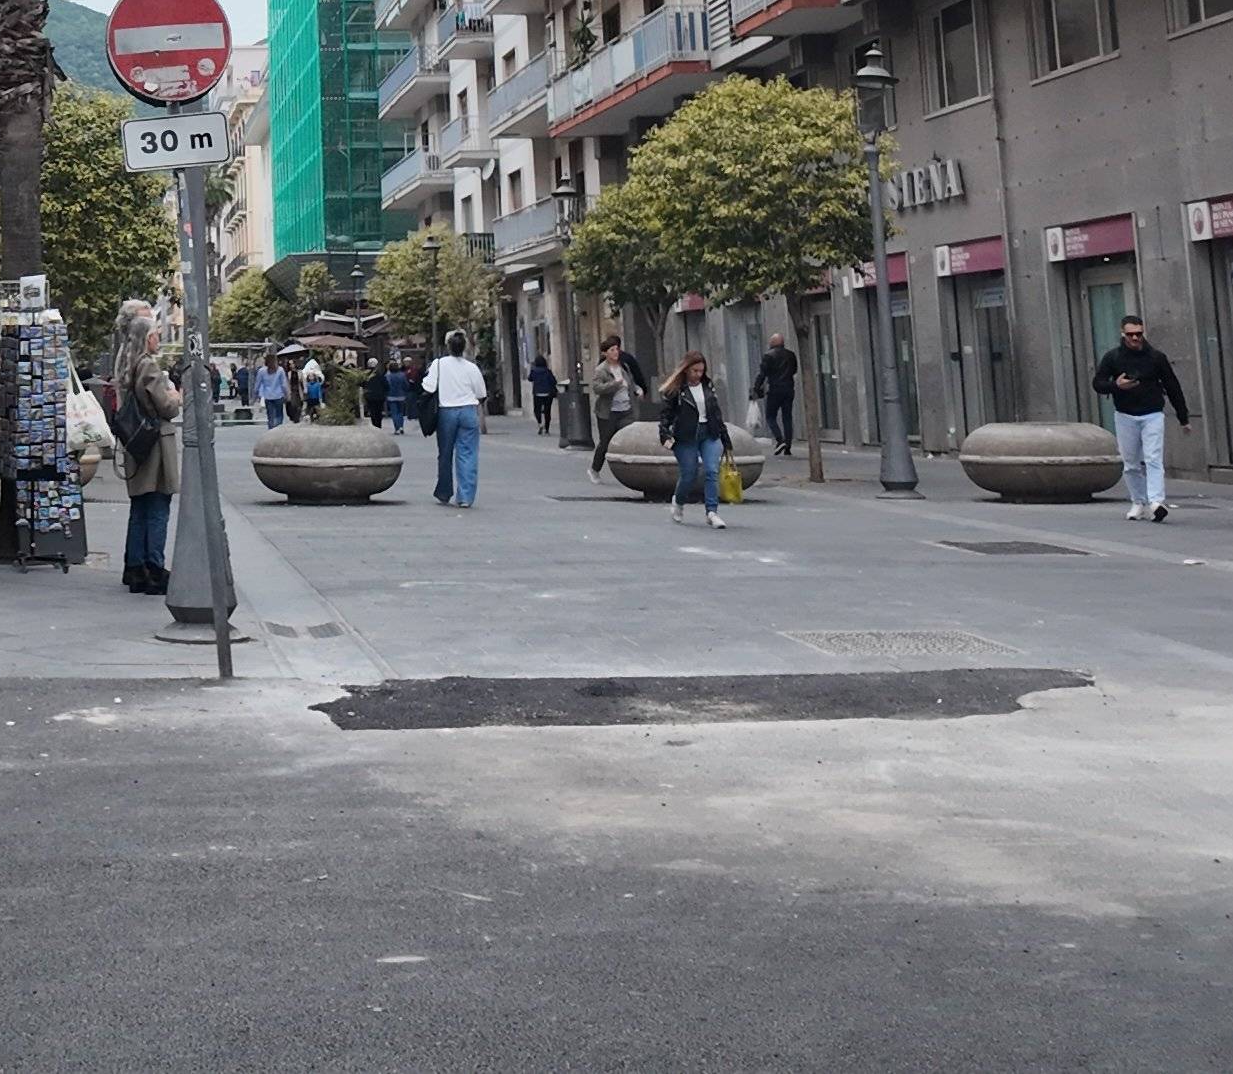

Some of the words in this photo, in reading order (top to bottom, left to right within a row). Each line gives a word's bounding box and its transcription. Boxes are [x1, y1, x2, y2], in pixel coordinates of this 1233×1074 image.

[140, 129, 179, 154] 30
[189, 132, 213, 150] m
[887, 158, 964, 211] SIENA
